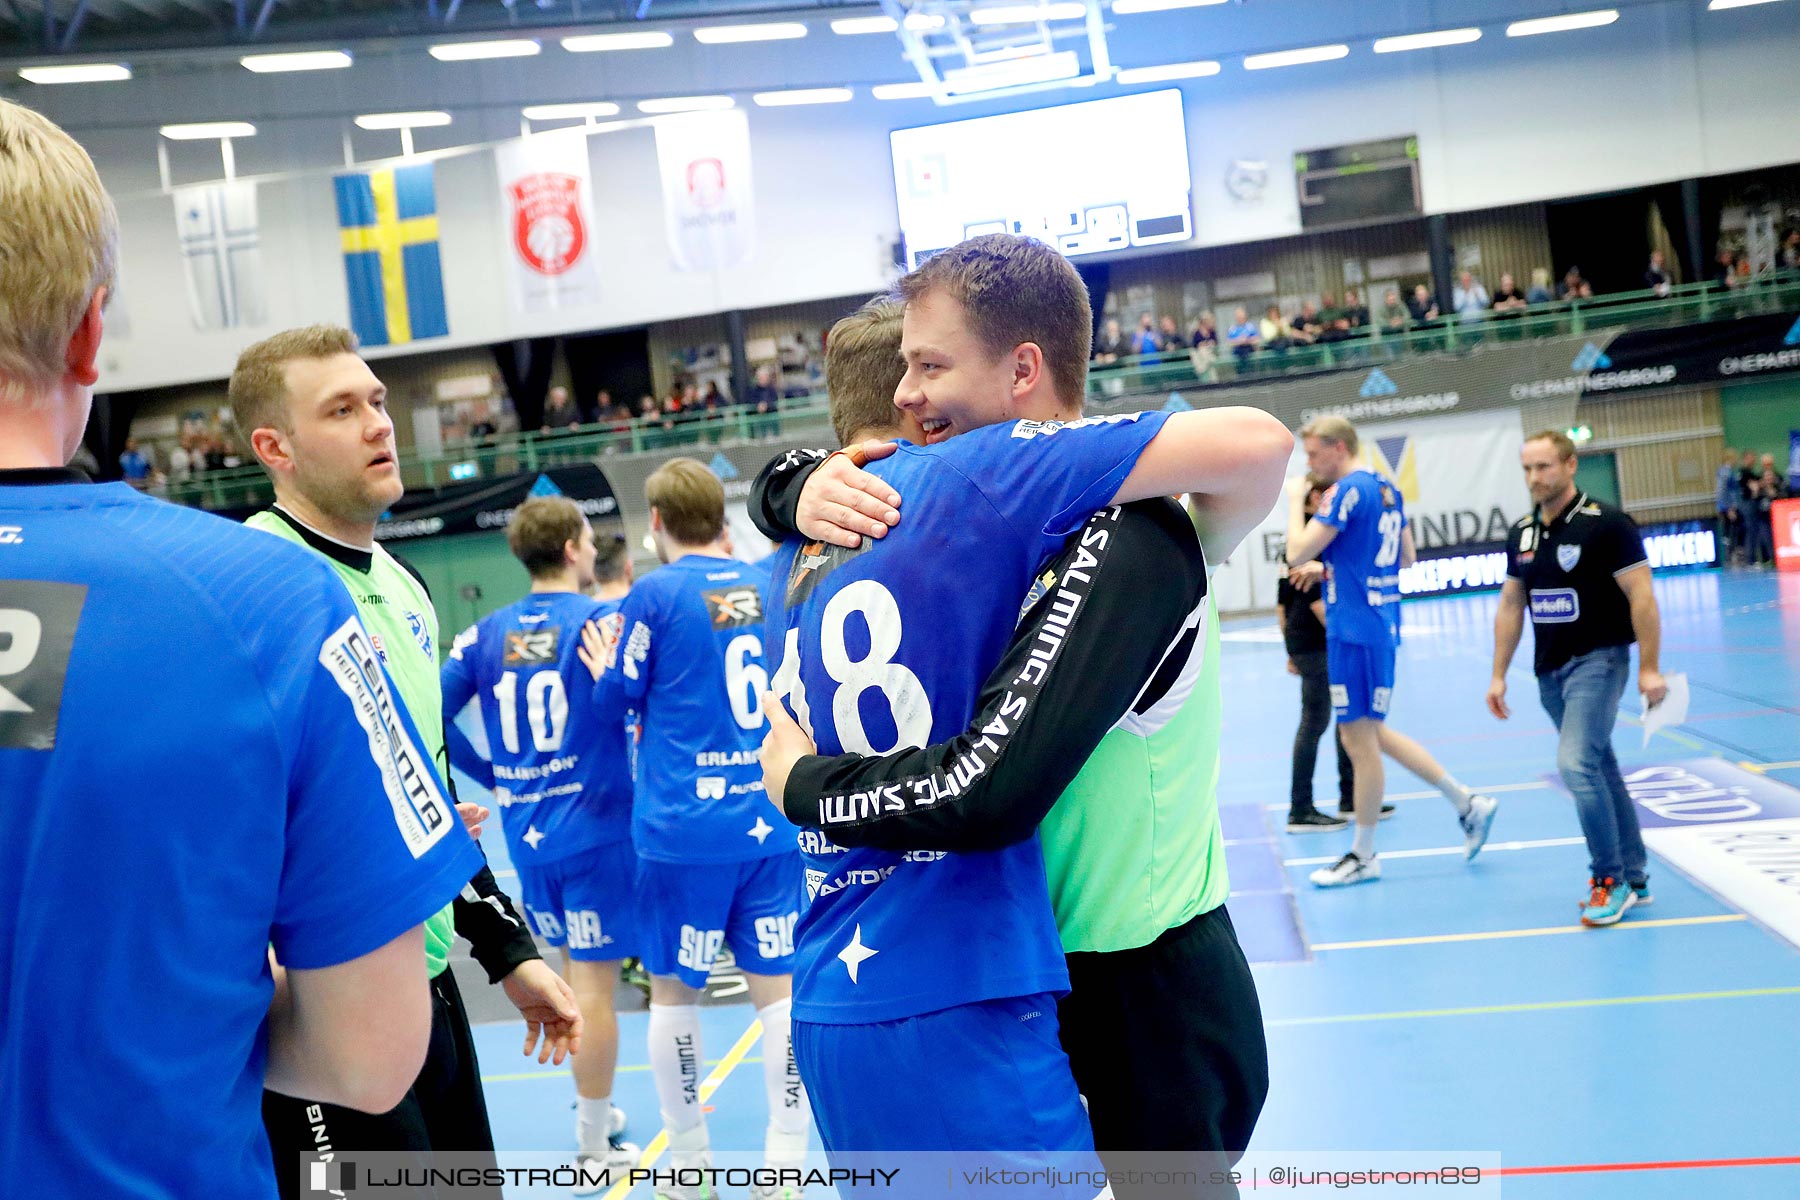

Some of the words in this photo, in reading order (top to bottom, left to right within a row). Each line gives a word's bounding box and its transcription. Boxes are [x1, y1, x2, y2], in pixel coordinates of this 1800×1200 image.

[1510, 364, 1677, 400] ONEPARTNERGROUP
[1643, 530, 1716, 569] VIKEN
[725, 634, 769, 730] 6
[771, 579, 934, 758] 18
[493, 669, 569, 754] 10
